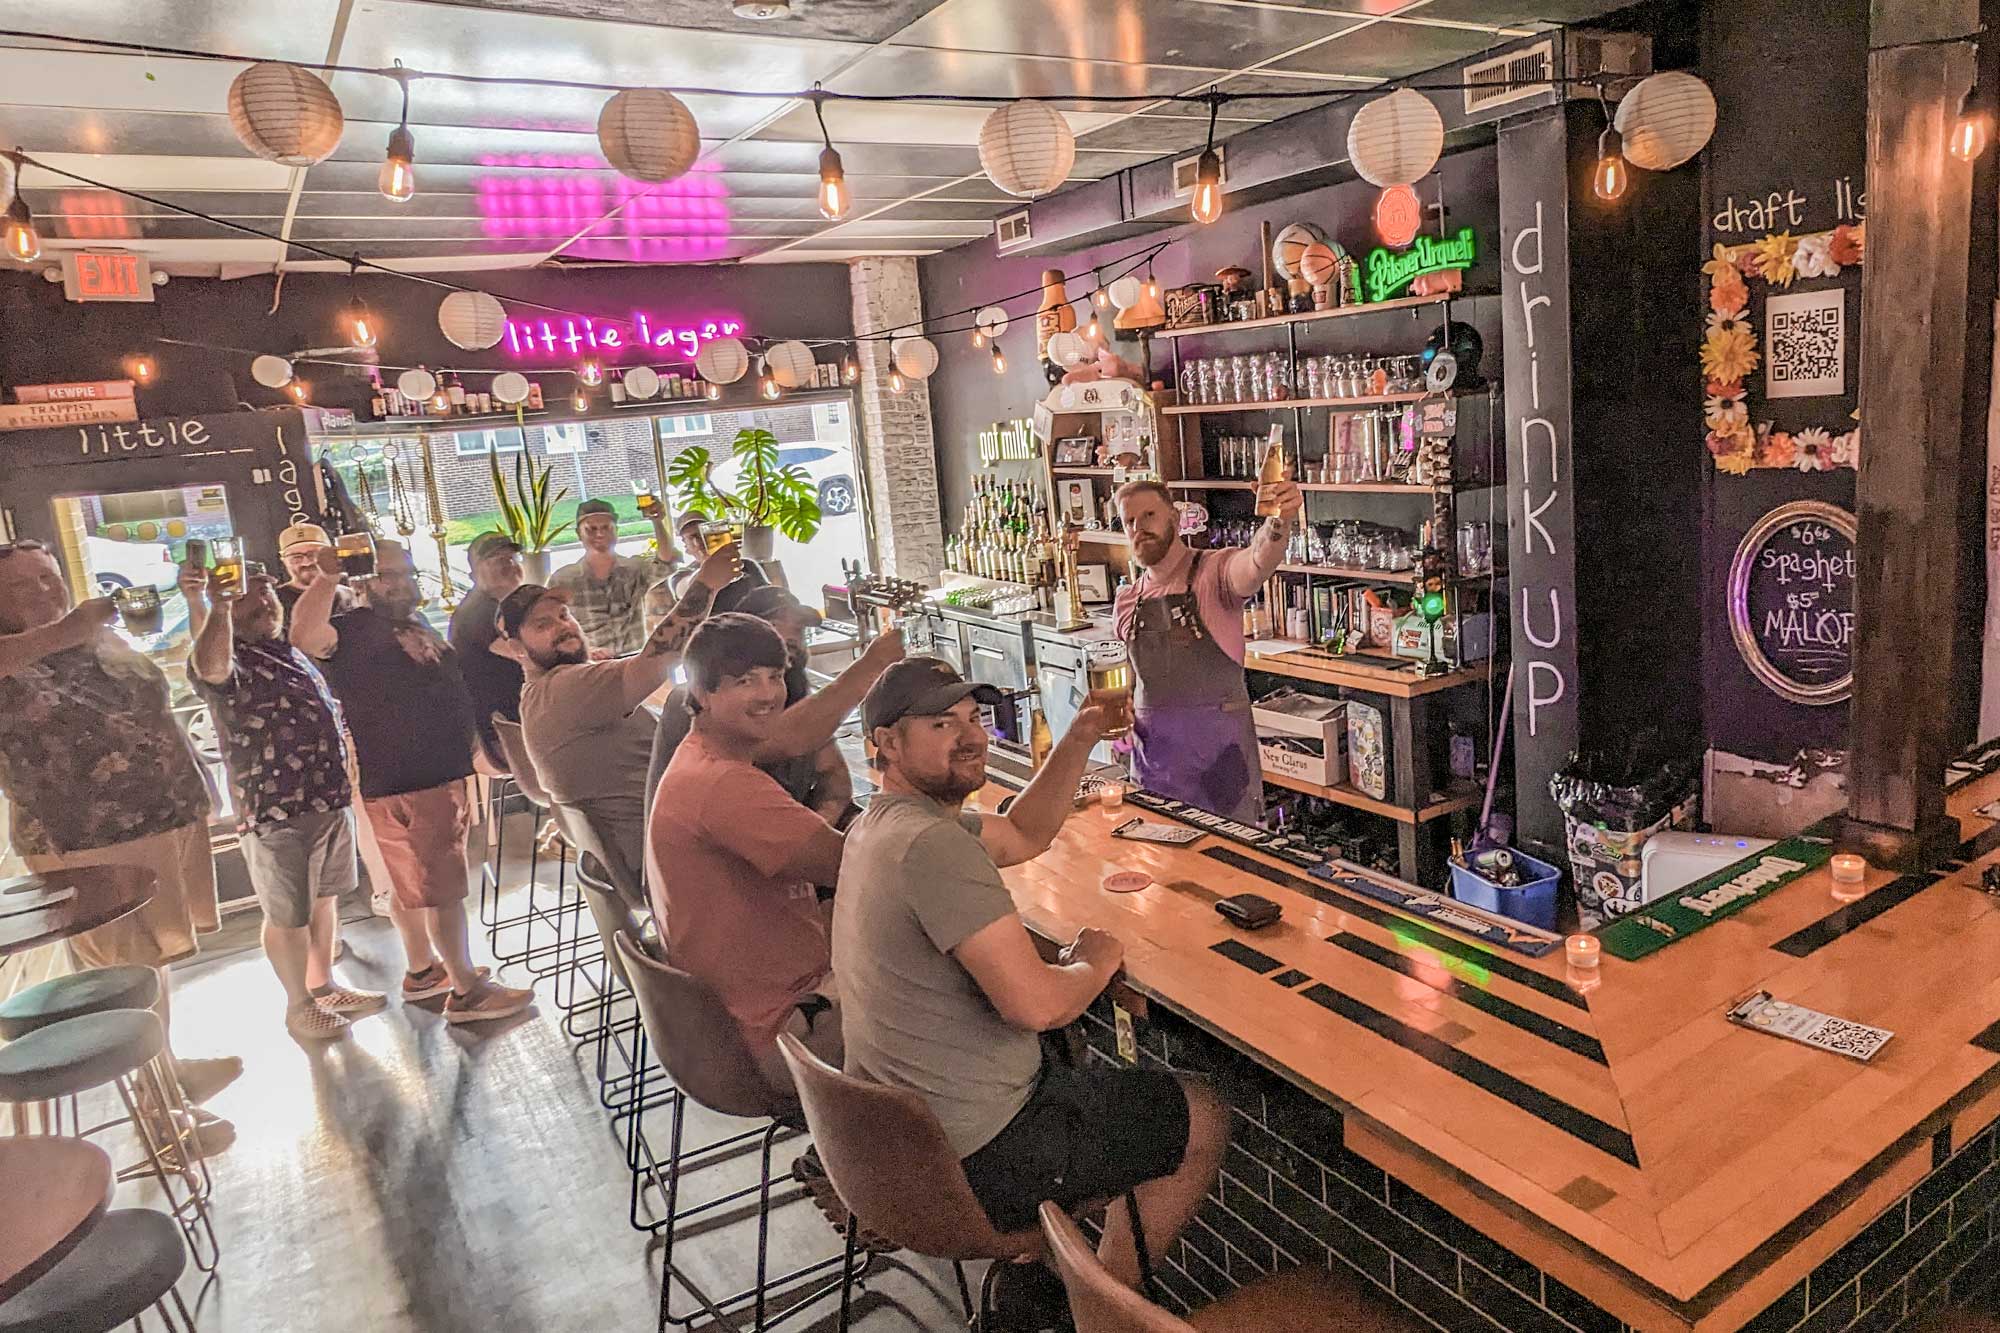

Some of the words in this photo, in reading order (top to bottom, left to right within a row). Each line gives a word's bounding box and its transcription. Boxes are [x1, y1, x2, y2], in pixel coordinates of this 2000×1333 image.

[1713, 190, 1806, 232] draft
[76, 255, 139, 295] EXIT
[1369, 249, 1420, 301] Pilsner
[509, 318, 622, 353] little
[639, 313, 741, 357] lager
[48, 386, 96, 399] KEWPIE
[79, 420, 211, 454] little
[979, 423, 1000, 468] got
[1001, 418, 1036, 460] milk?
